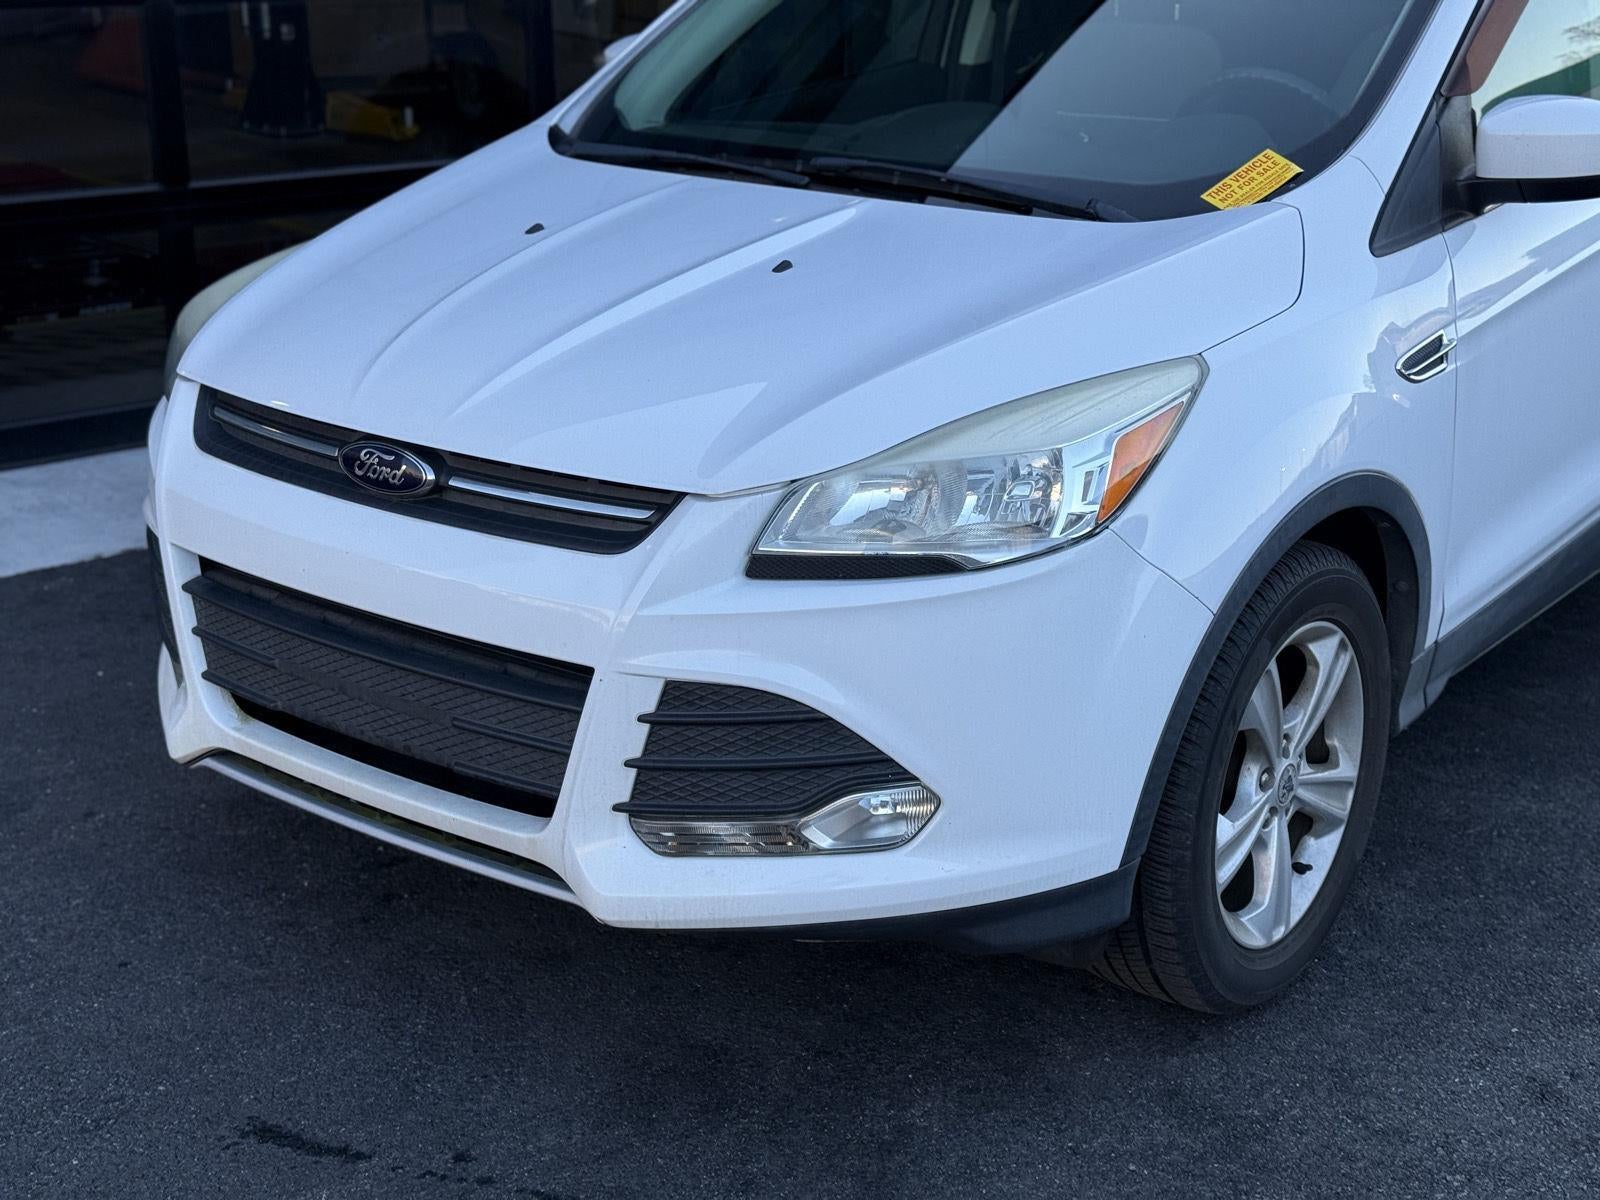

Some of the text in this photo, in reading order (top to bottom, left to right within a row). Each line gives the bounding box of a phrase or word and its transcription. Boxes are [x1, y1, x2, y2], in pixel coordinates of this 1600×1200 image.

[1206, 182, 1233, 199] THIS
[1230, 152, 1274, 182] VEHICLE
[1218, 160, 1280, 203] NOT FOR SALE
[354, 448, 407, 485] Ford
